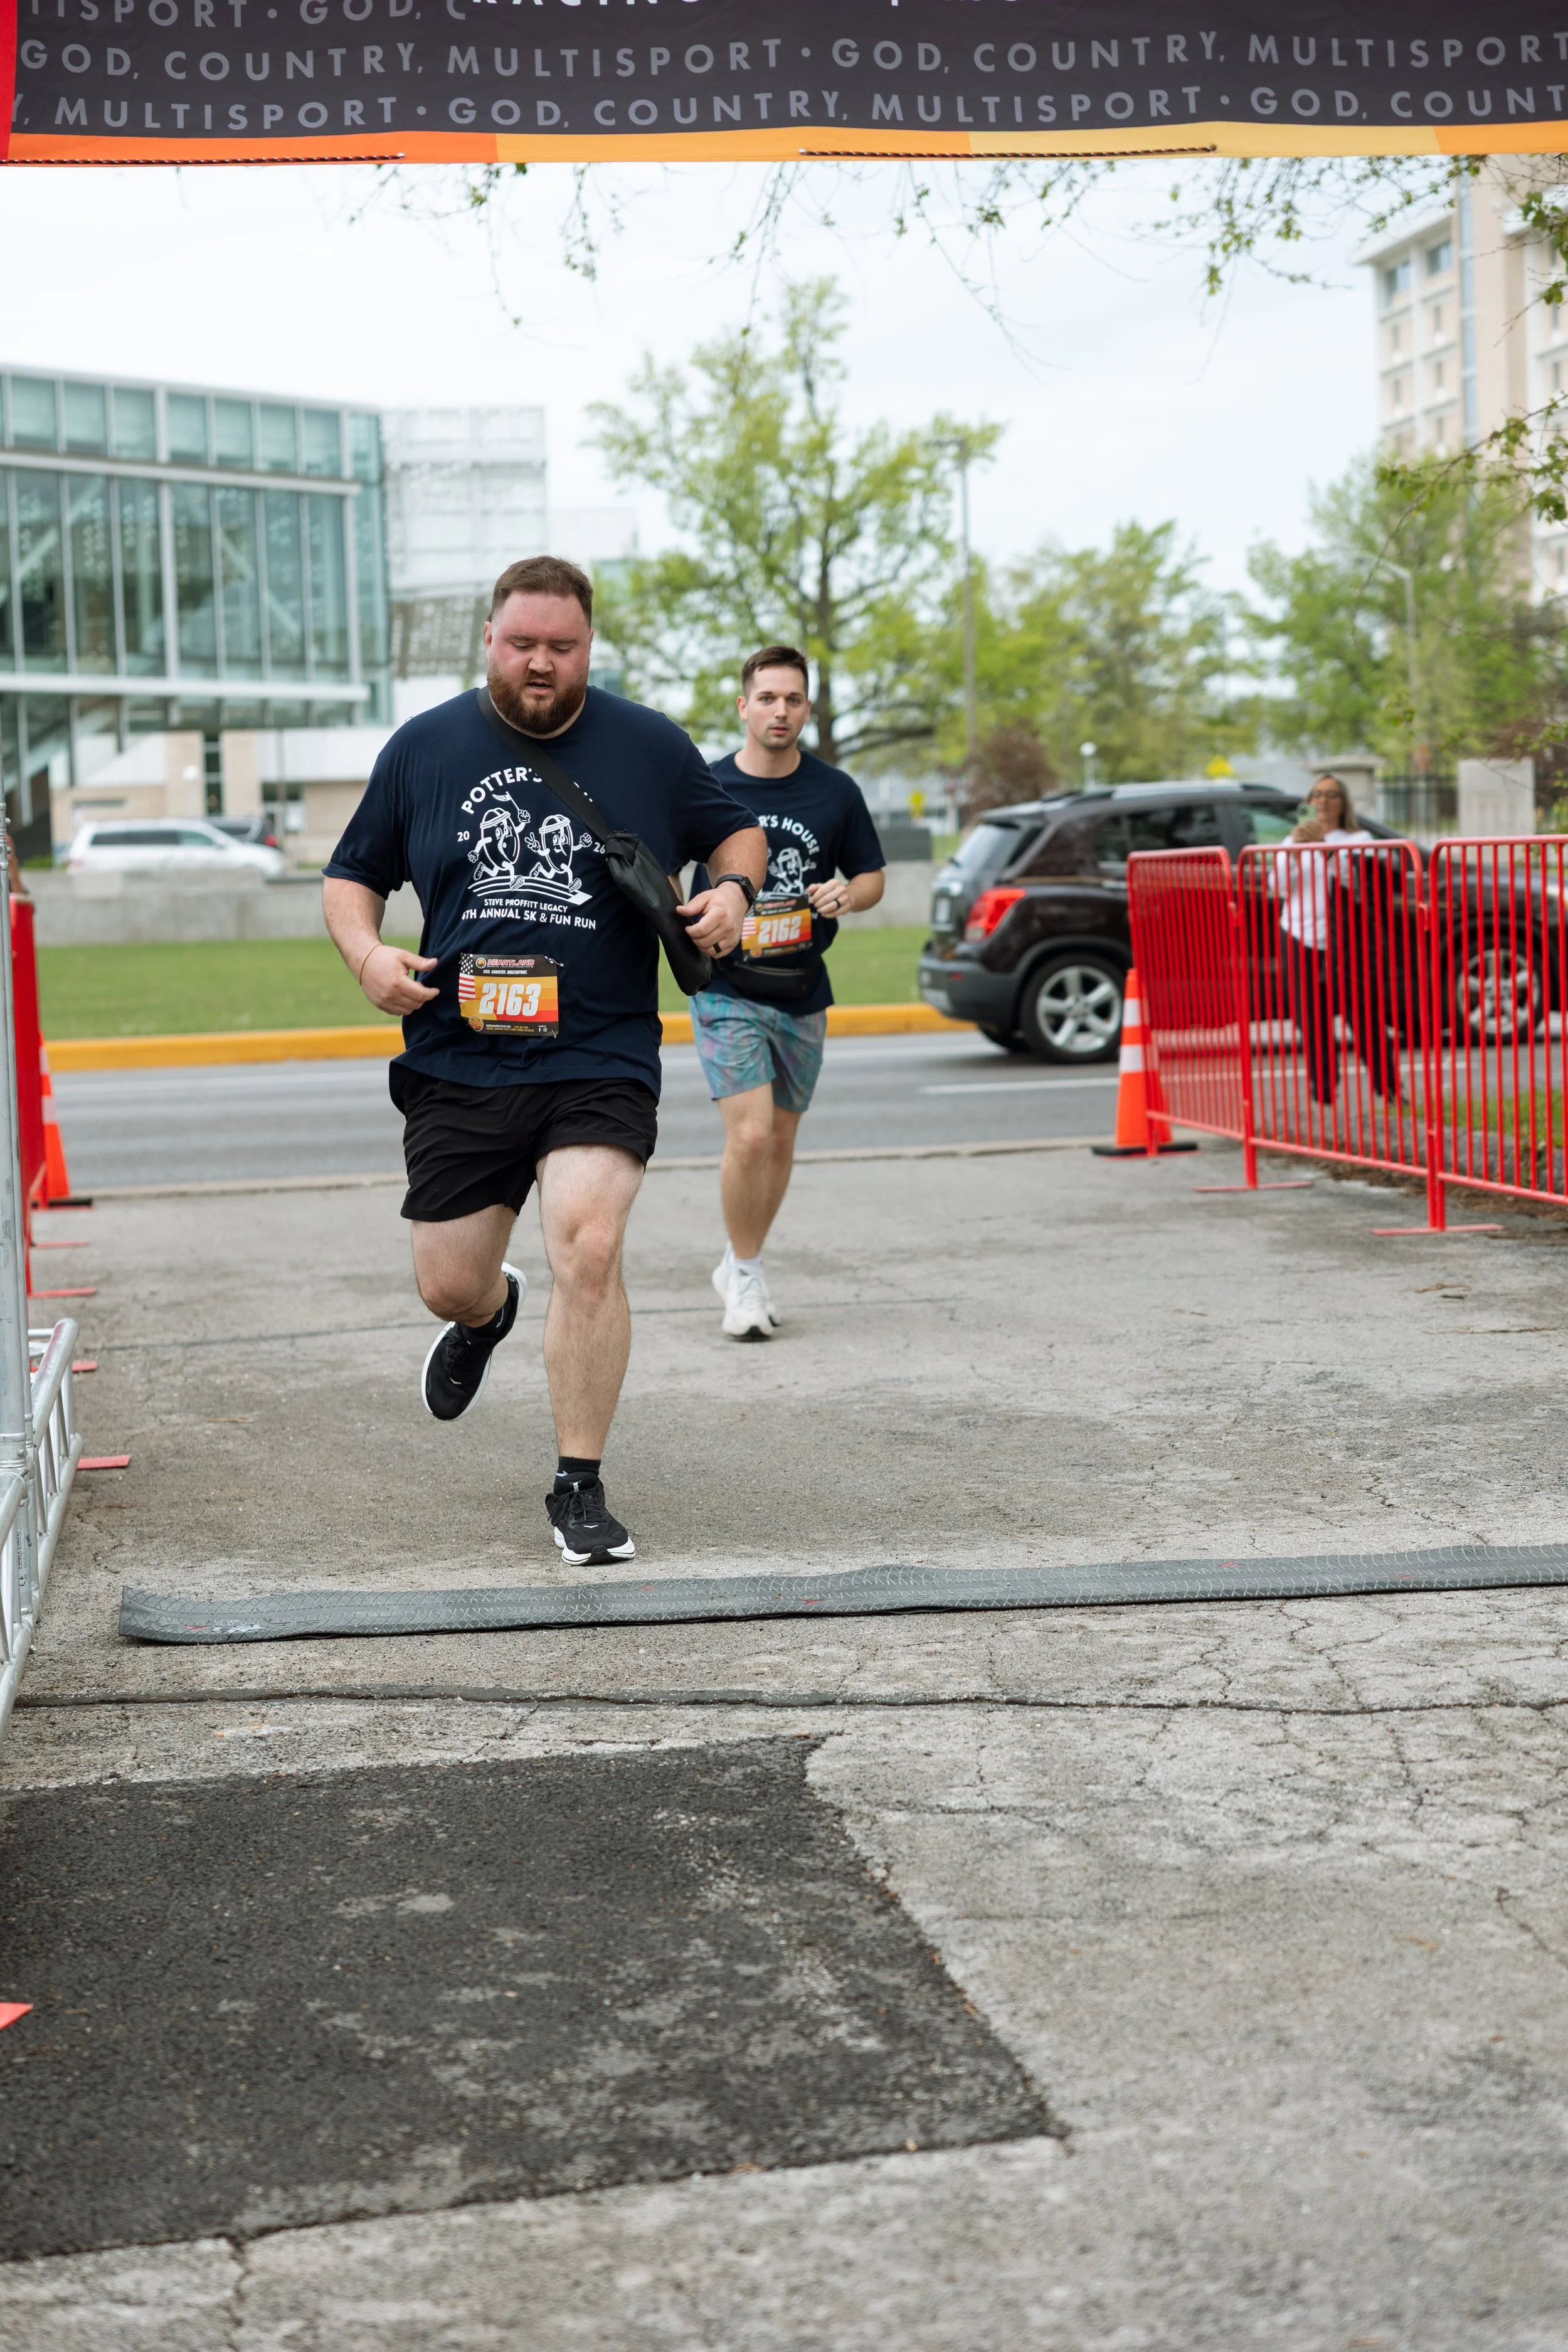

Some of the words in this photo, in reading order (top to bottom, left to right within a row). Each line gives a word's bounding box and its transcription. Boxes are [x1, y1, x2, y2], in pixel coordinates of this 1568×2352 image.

[21, 40, 139, 80] GOD,
[164, 43, 424, 81] COUNTRY,
[447, 38, 781, 77] MULTISPORT
[831, 38, 950, 74] GOD,
[973, 31, 1226, 73] COUNTRY,
[1248, 32, 1568, 68] MULTISPORT
[54, 96, 397, 130] MULTISPORT
[448, 97, 569, 129] GOD,
[593, 90, 848, 127] COUNTRY,
[871, 85, 1200, 124] MULTISPORT
[1250, 87, 1367, 120] GOD,
[1389, 85, 1565, 118] COUNT
[457, 830, 470, 842] 20
[593, 842, 605, 854] 26
[781, 817, 820, 856] HOUSE
[479, 908, 521, 919] ANNUAL
[523, 910, 537, 921] 5K
[539, 913, 548, 923] &
[549, 913, 571, 926] FUN
[574, 916, 596, 930] RUN
[484, 898, 504, 906] STEVE
[505, 899, 539, 909] PROFFITT
[539, 902, 568, 913] LEGACY
[758, 915, 802, 945] 2162
[479, 983, 541, 1016] 2163
